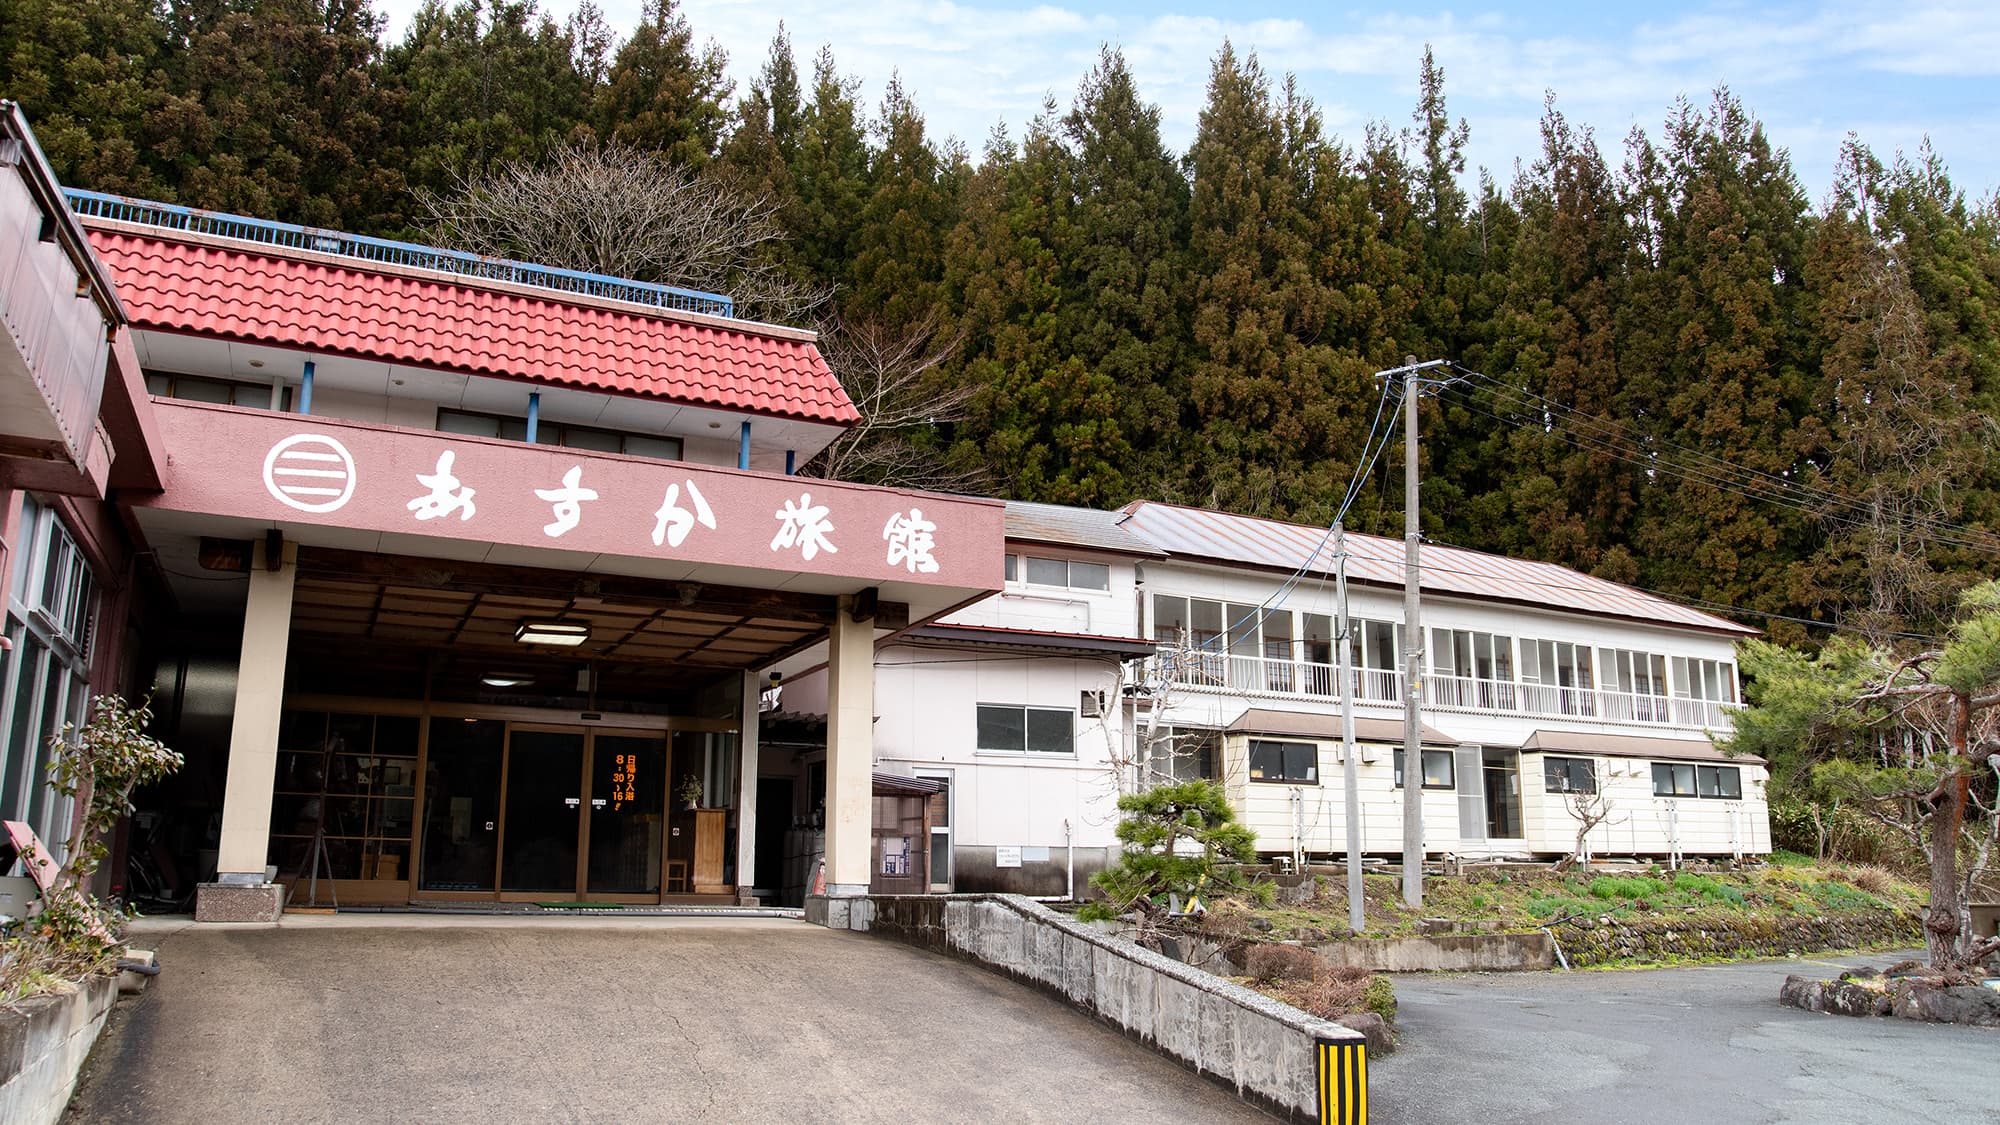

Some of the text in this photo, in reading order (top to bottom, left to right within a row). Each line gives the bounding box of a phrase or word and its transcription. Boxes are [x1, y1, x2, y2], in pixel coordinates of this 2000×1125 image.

[406, 449, 941, 575] あすか旅館
[625, 754, 636, 801] 日帰り入浴
